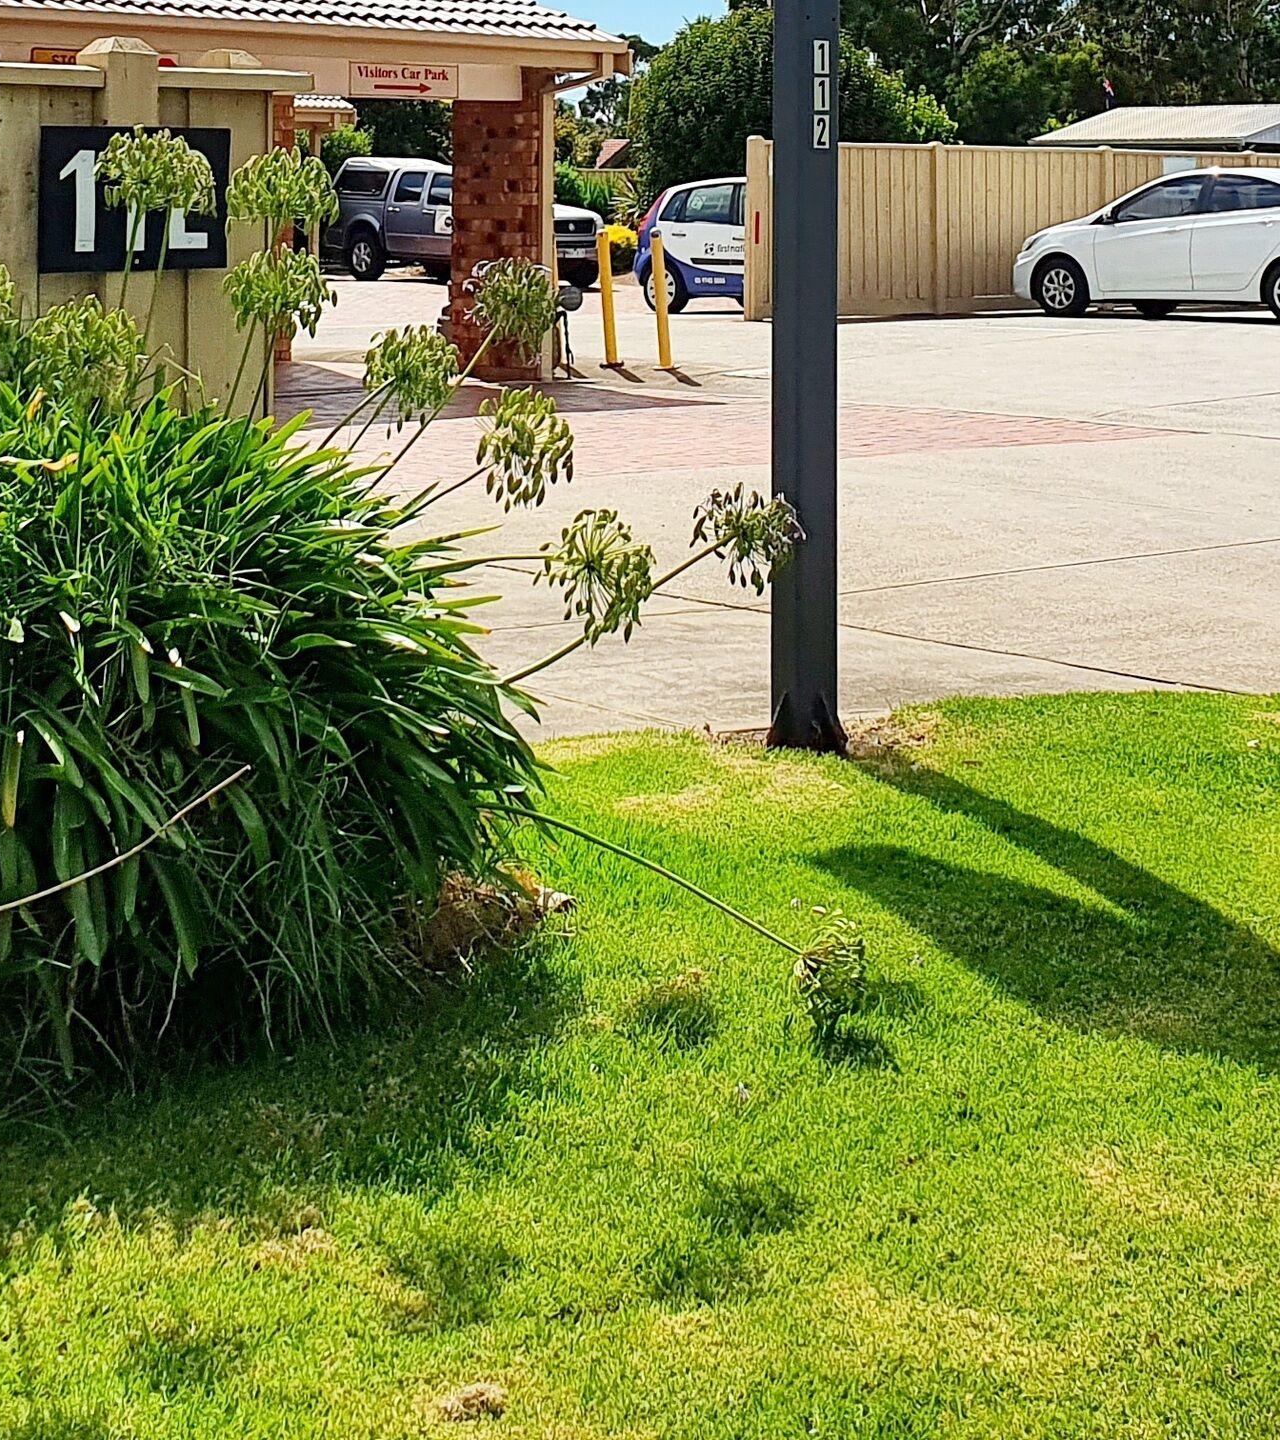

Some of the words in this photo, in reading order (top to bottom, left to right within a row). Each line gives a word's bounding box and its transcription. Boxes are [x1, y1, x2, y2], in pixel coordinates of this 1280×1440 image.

[357, 66, 398, 79] Visitors
[401, 68, 421, 80] Car
[424, 69, 449, 81] Park
[816, 42, 827, 146] 112
